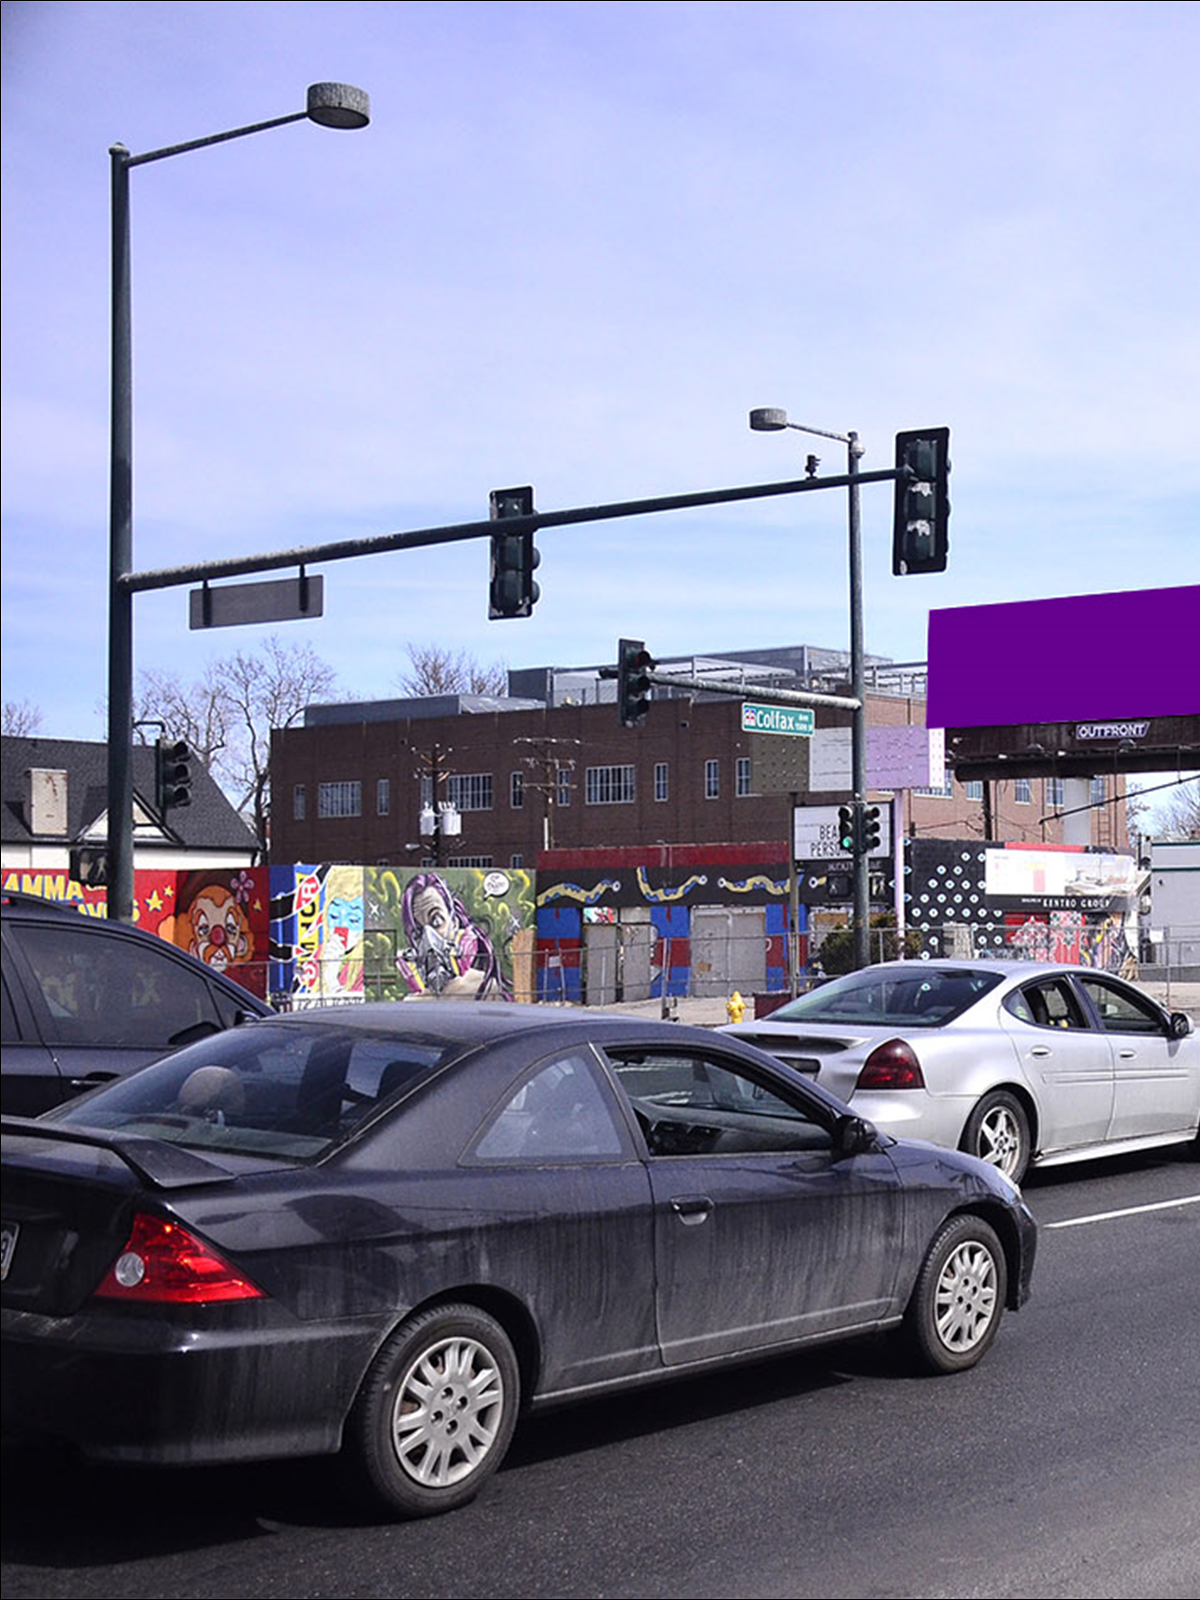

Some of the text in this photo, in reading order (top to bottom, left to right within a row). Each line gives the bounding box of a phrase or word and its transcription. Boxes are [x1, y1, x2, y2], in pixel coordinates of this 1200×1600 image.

[756, 710, 795, 731] Colfax
[1078, 723, 1147, 738] OUTFRONT
[1, 873, 84, 902] AMMA
[1043, 898, 1077, 908] KENTRO
